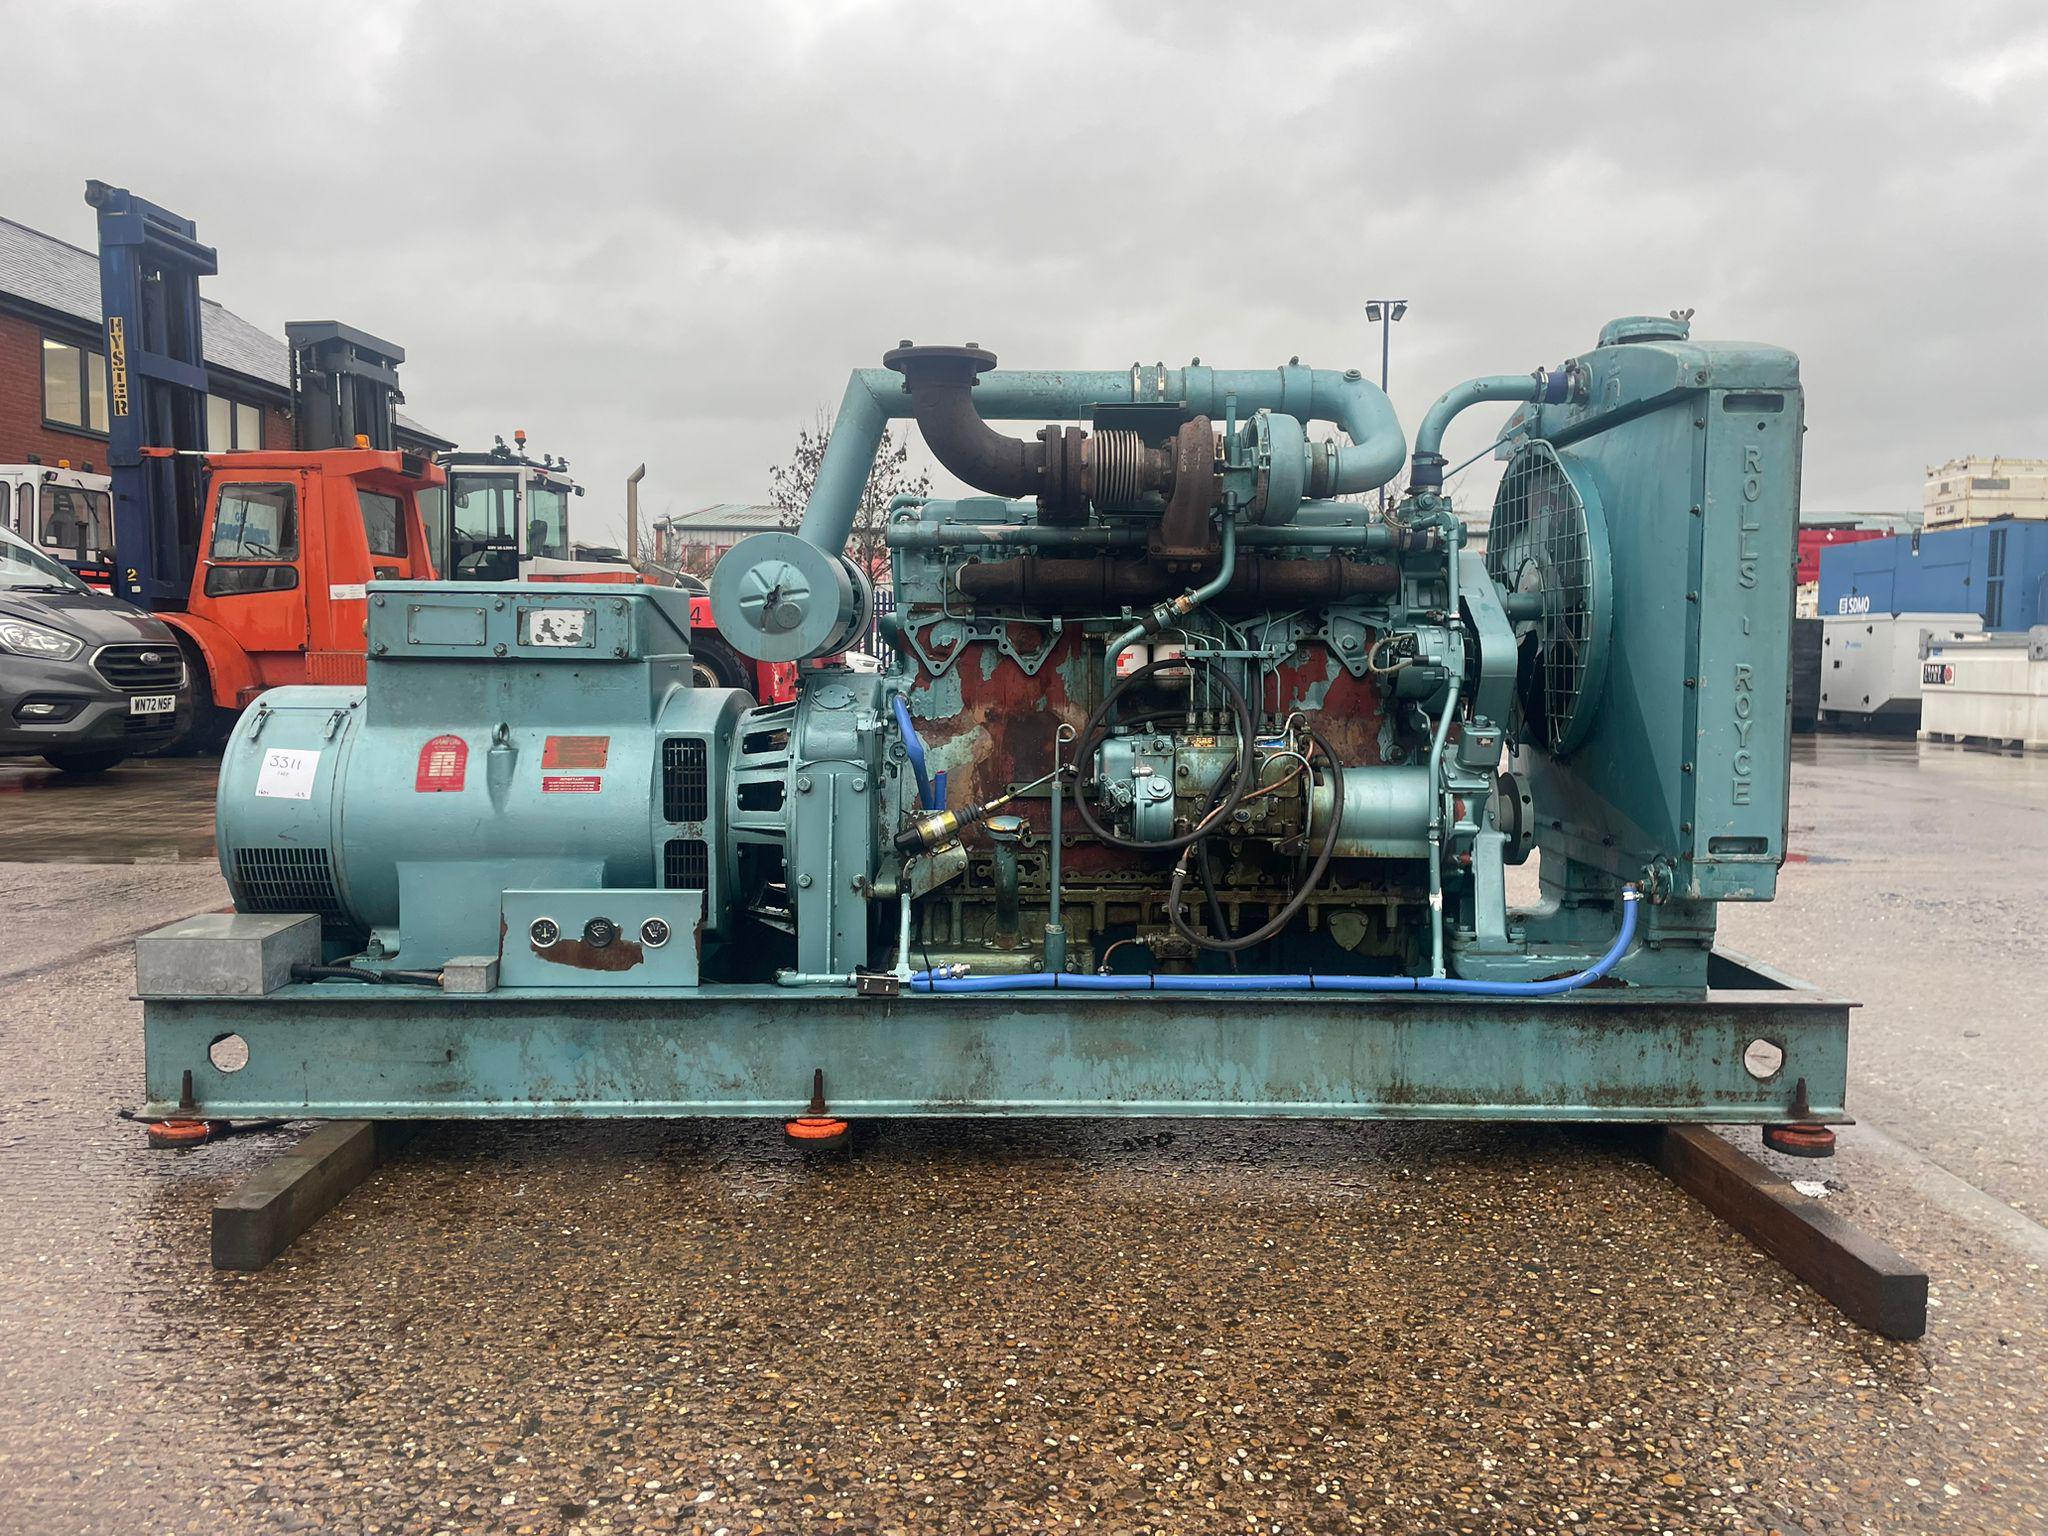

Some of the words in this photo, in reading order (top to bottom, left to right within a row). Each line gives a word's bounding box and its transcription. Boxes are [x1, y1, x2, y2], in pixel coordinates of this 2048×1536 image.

[110, 318, 127, 415] HYSTER
[1739, 445, 1762, 589] ROLLS
[127, 568, 137, 582] 2
[1848, 596, 1870, 613] SDMO
[690, 606, 702, 625] 4
[134, 698, 157, 712] WN72
[158, 697, 172, 710] NSF
[1732, 663, 1753, 806] ROYCE
